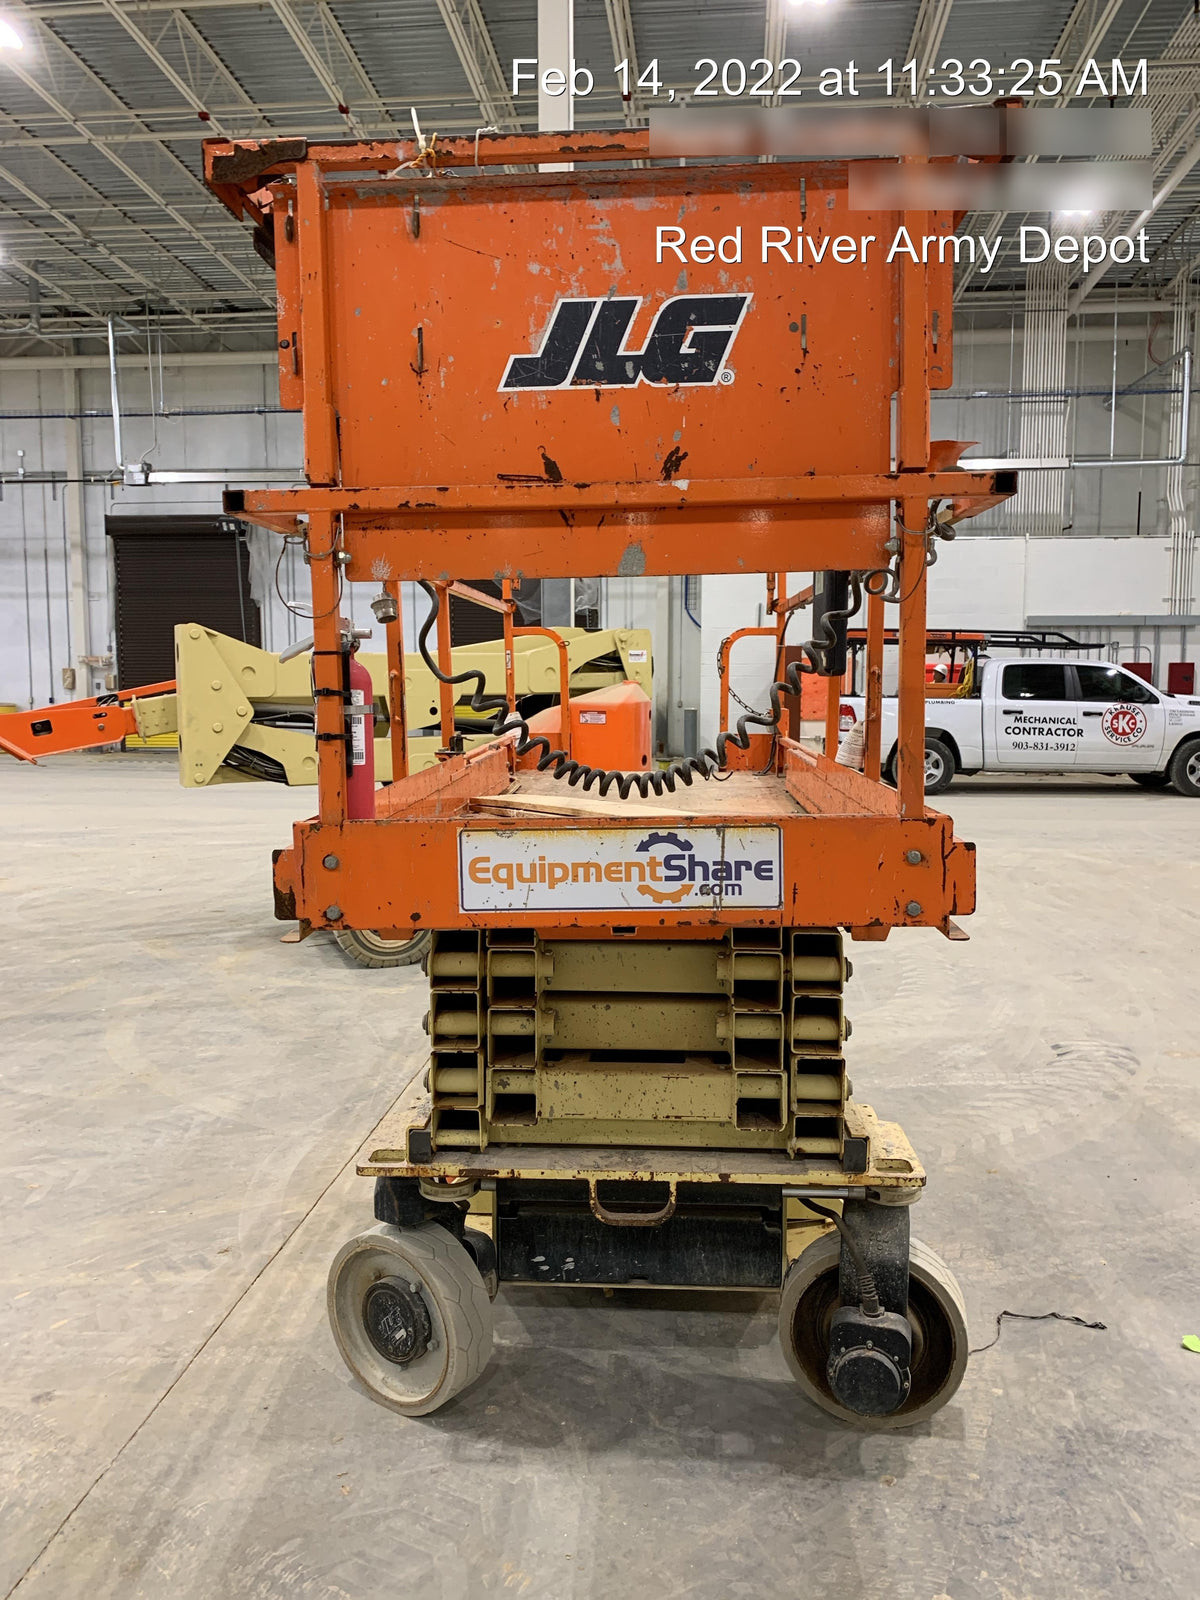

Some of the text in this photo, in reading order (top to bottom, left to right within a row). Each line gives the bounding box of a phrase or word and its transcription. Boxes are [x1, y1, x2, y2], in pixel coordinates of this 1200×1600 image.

[498, 293, 753, 392] JLG
[1013, 715, 1078, 725] MECHANICAL
[1004, 726, 1084, 738] CONTRACTOR
[1105, 725, 1132, 743] SERVICE
[1012, 741, 1076, 752] 903-831-3912
[468, 853, 774, 890] EquipmentShare
[694, 883, 743, 896] .com
